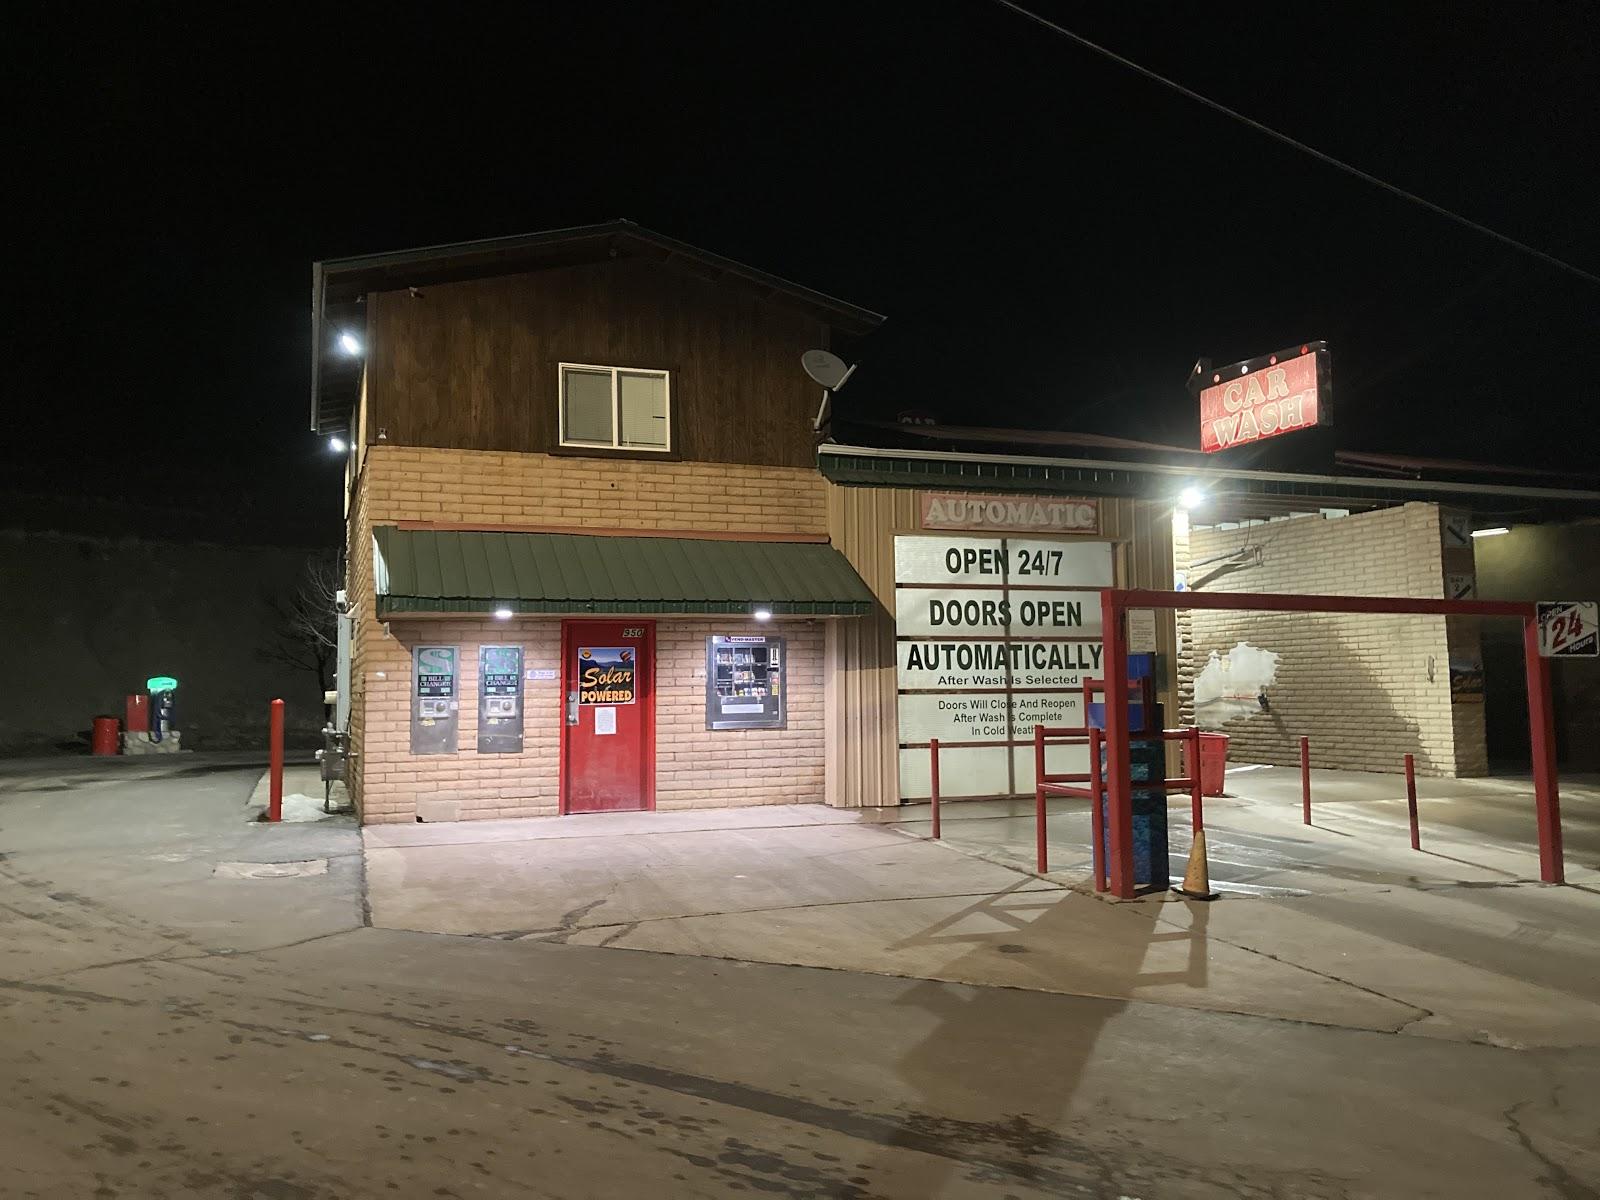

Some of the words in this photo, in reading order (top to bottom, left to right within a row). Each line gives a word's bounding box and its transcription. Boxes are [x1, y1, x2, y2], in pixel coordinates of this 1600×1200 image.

[1223, 368, 1290, 413] CAR
[1212, 395, 1303, 447] WASH
[925, 498, 1097, 529] AUTOMATIC
[945, 547, 1010, 575] OPEN
[1017, 549, 1063, 576] 24/7
[929, 599, 1012, 627] DOORS
[1019, 600, 1082, 627] OPEN
[623, 629, 644, 637] 950
[1552, 609, 1584, 649] 24
[906, 643, 1103, 671] AUTOMATICALLY
[580, 665, 632, 688] Solar
[938, 675, 968, 685] After
[972, 675, 1008, 685] Wash
[1011, 675, 1022, 685] Is
[1025, 675, 1078, 685] Selected
[580, 690, 633, 702] POWERED
[938, 700, 968, 710] Doors
[971, 700, 988, 710] Will
[1019, 699, 1038, 709] And
[1041, 698, 1076, 712] Reopen
[953, 714, 976, 723] After
[979, 713, 1005, 723] Wash
[1018, 712, 1062, 724] Complete
[971, 726, 981, 736] In
[983, 725, 1005, 736] Cold
